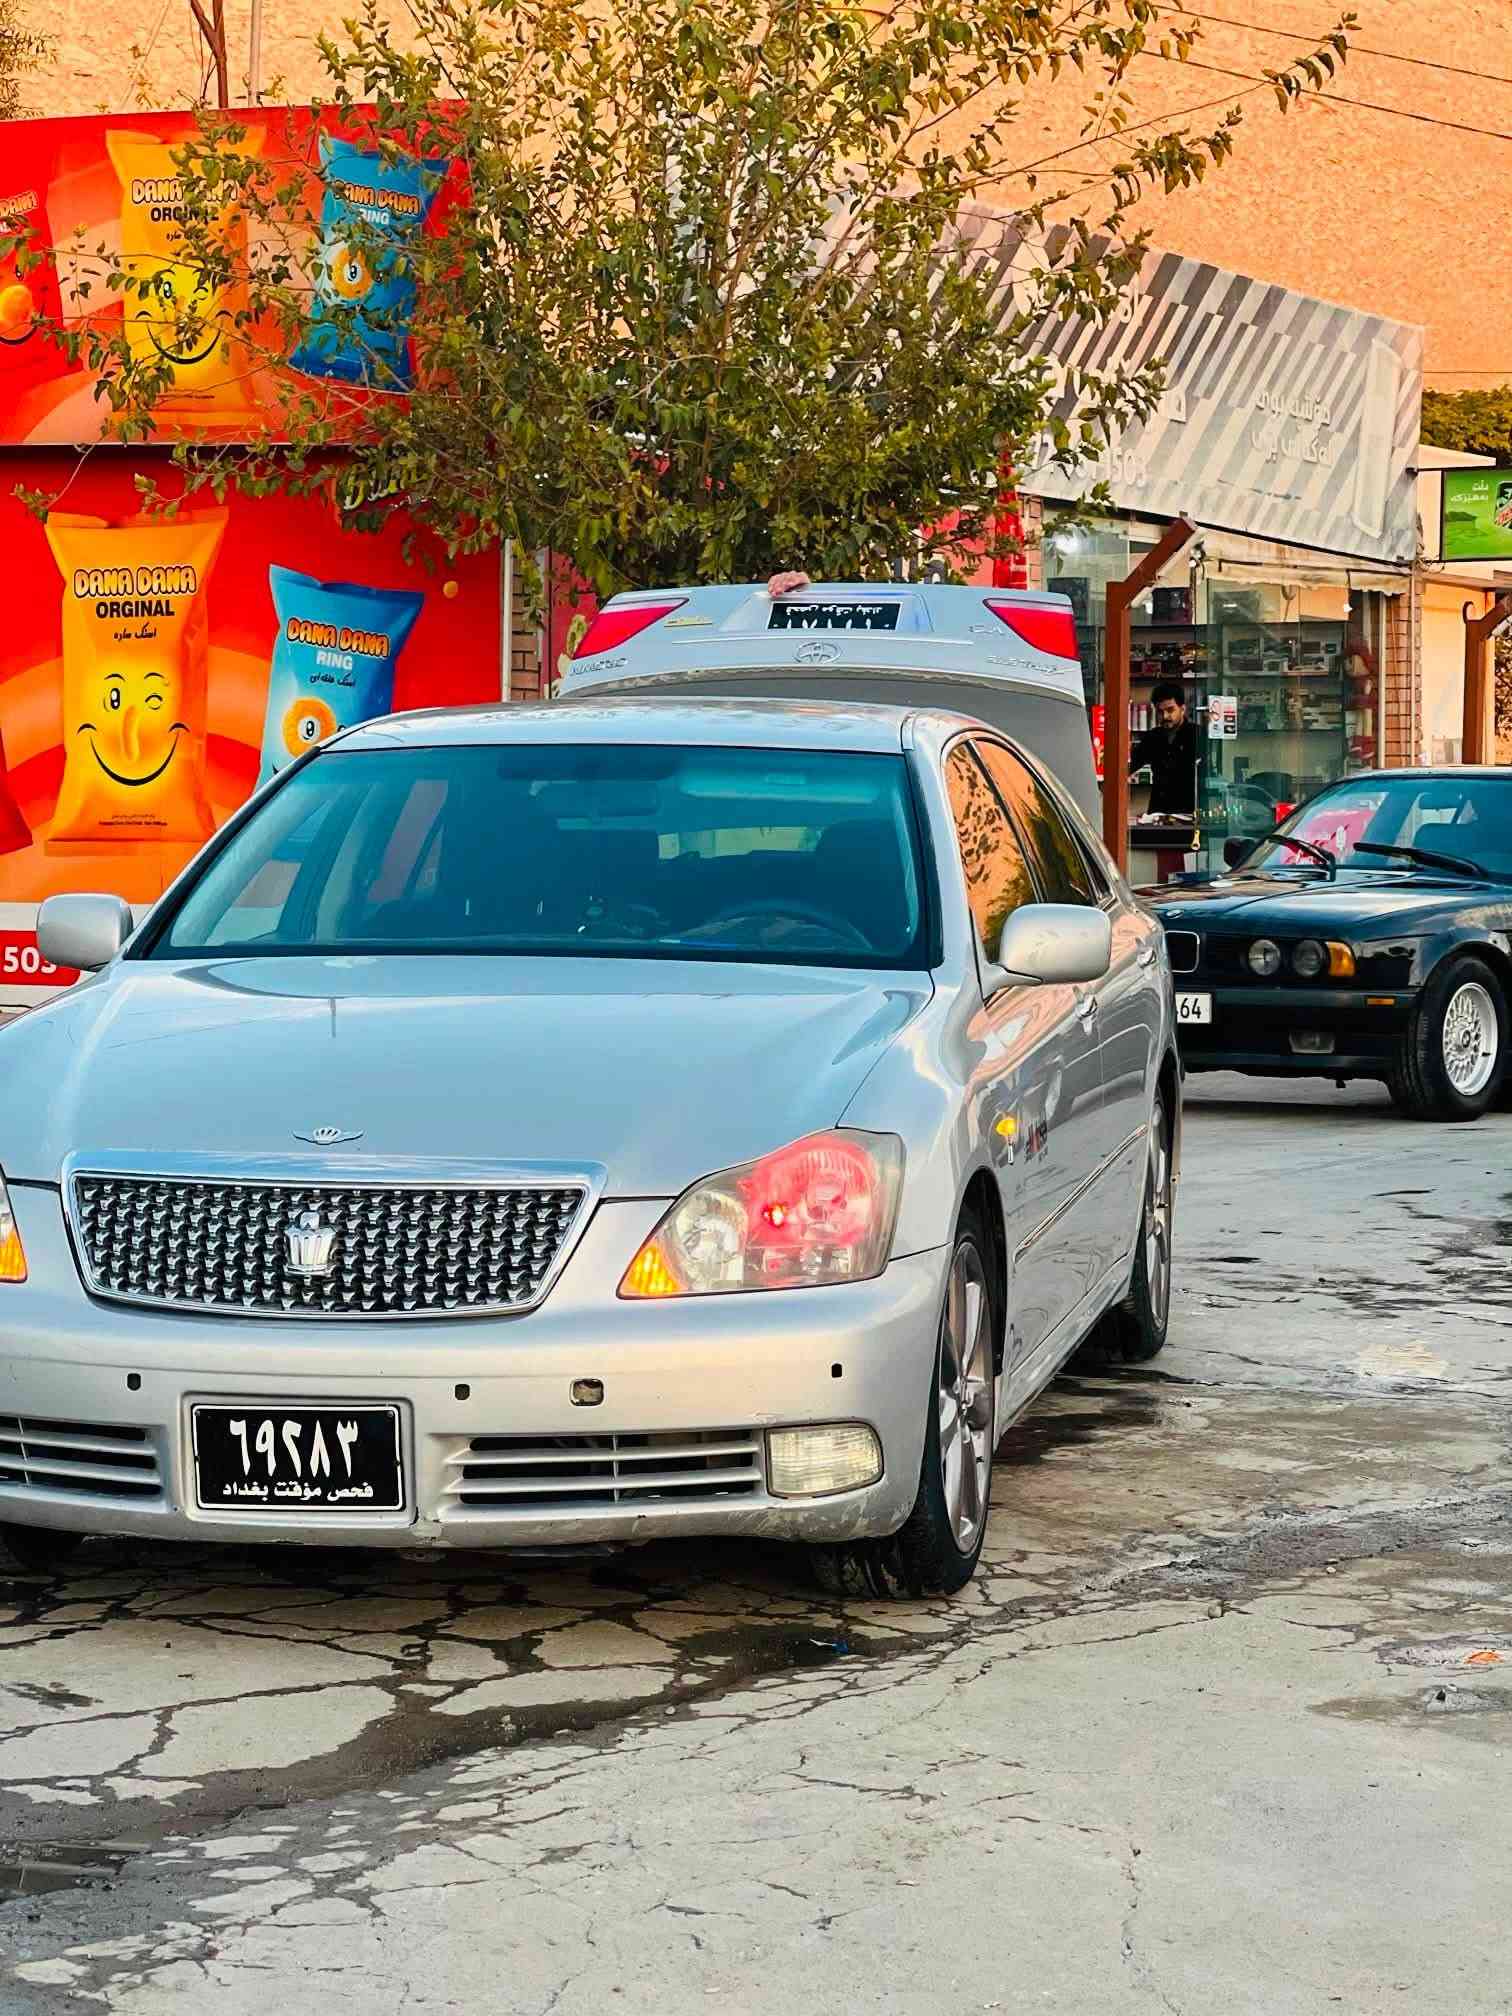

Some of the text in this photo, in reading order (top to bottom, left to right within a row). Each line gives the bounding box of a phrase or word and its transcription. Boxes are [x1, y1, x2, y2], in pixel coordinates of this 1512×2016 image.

[74, 565, 196, 598] DANA DANA
[96, 600, 175, 618] ORGINAL
[286, 617, 390, 658] DANA DANA
[316, 650, 353, 671] RING
[1180, 997, 1202, 1019] 64
[229, 1418, 359, 1478] ٦٩٢٨٣
[222, 1482, 269, 1501] بغداد
[327, 1481, 374, 1501] فحص
